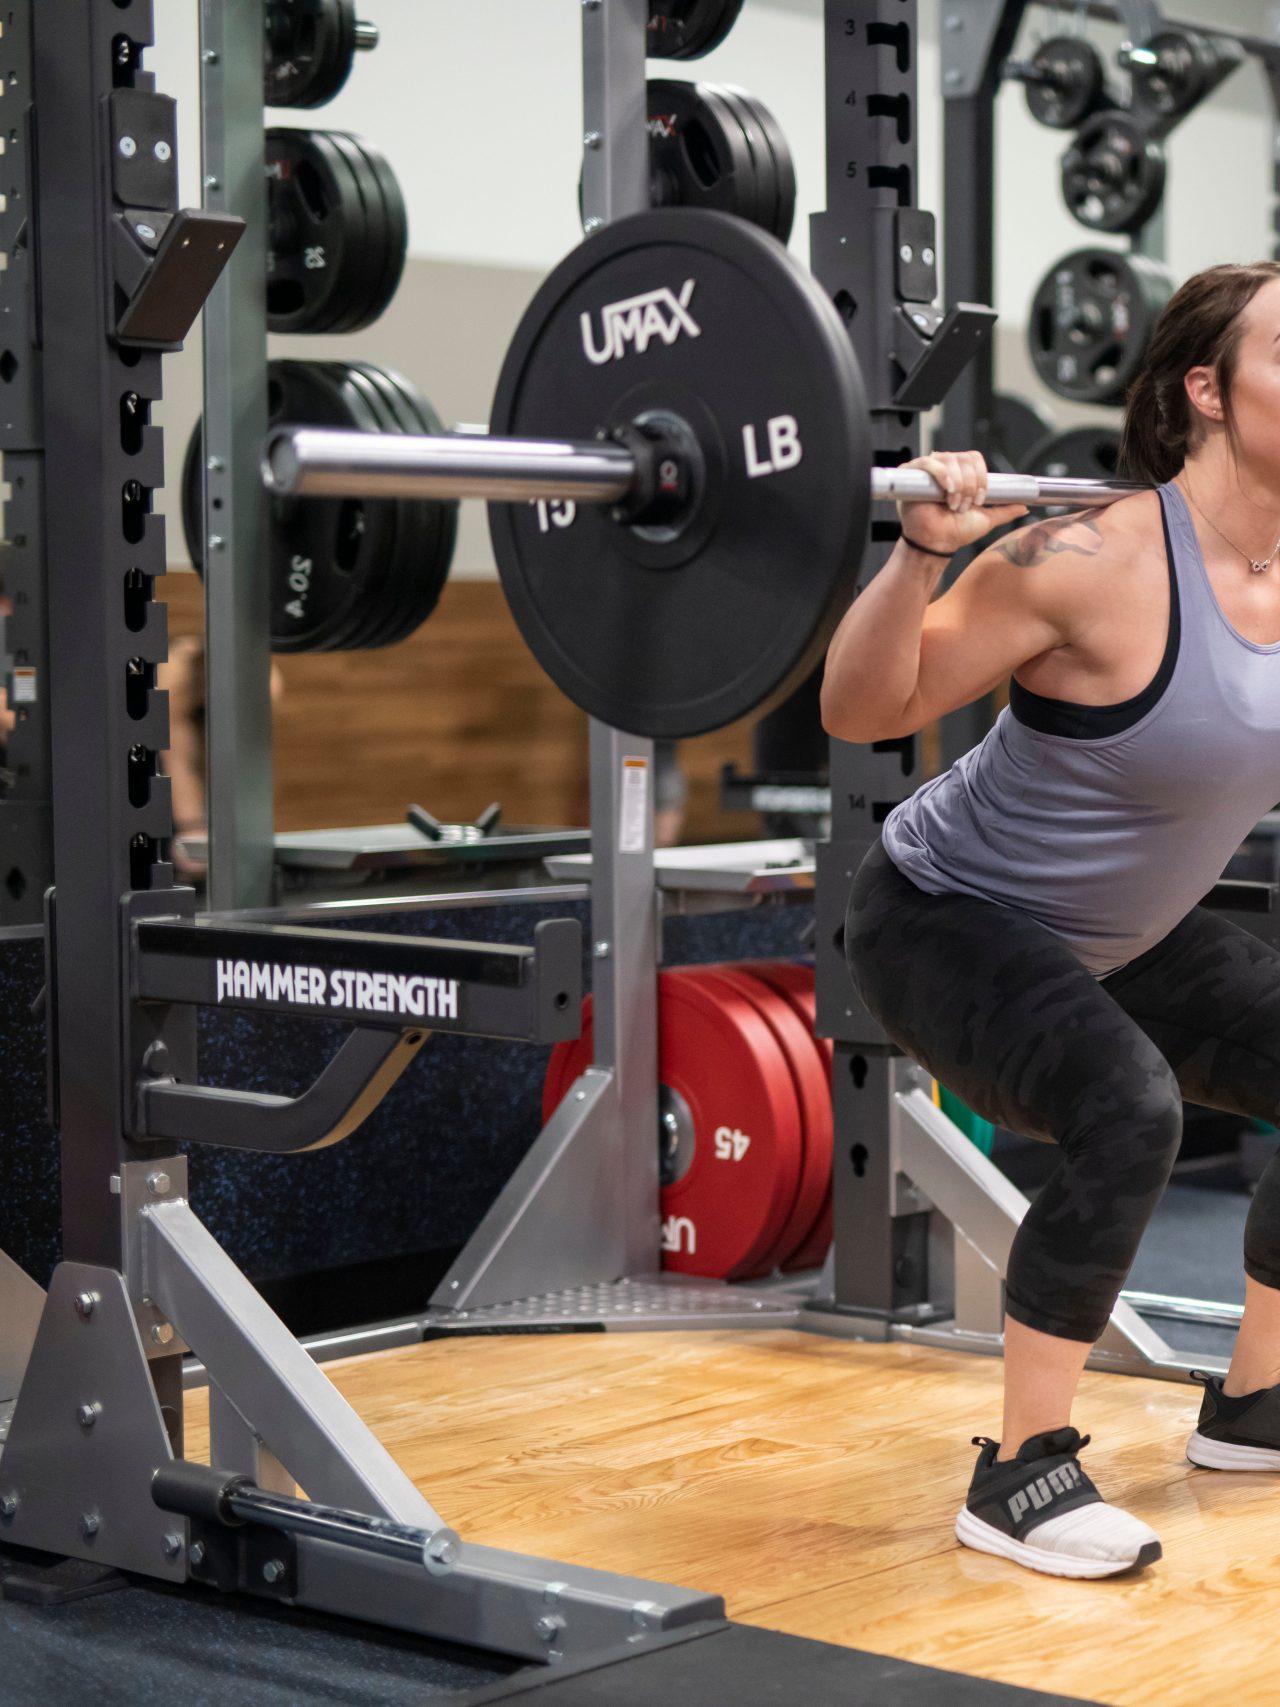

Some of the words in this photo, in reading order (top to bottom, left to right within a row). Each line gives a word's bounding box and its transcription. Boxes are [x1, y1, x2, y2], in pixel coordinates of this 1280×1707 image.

[844, 18, 856, 36] 3
[844, 90, 856, 106] 4
[846, 161, 857, 178] 5
[579, 278, 702, 365] UMAX
[742, 414, 803, 479] LB
[216, 959, 327, 1004] HAMMER
[330, 969, 458, 1019] STRENGTH
[714, 1125, 751, 1162] 45
[1007, 1461, 1082, 1524] PUM
